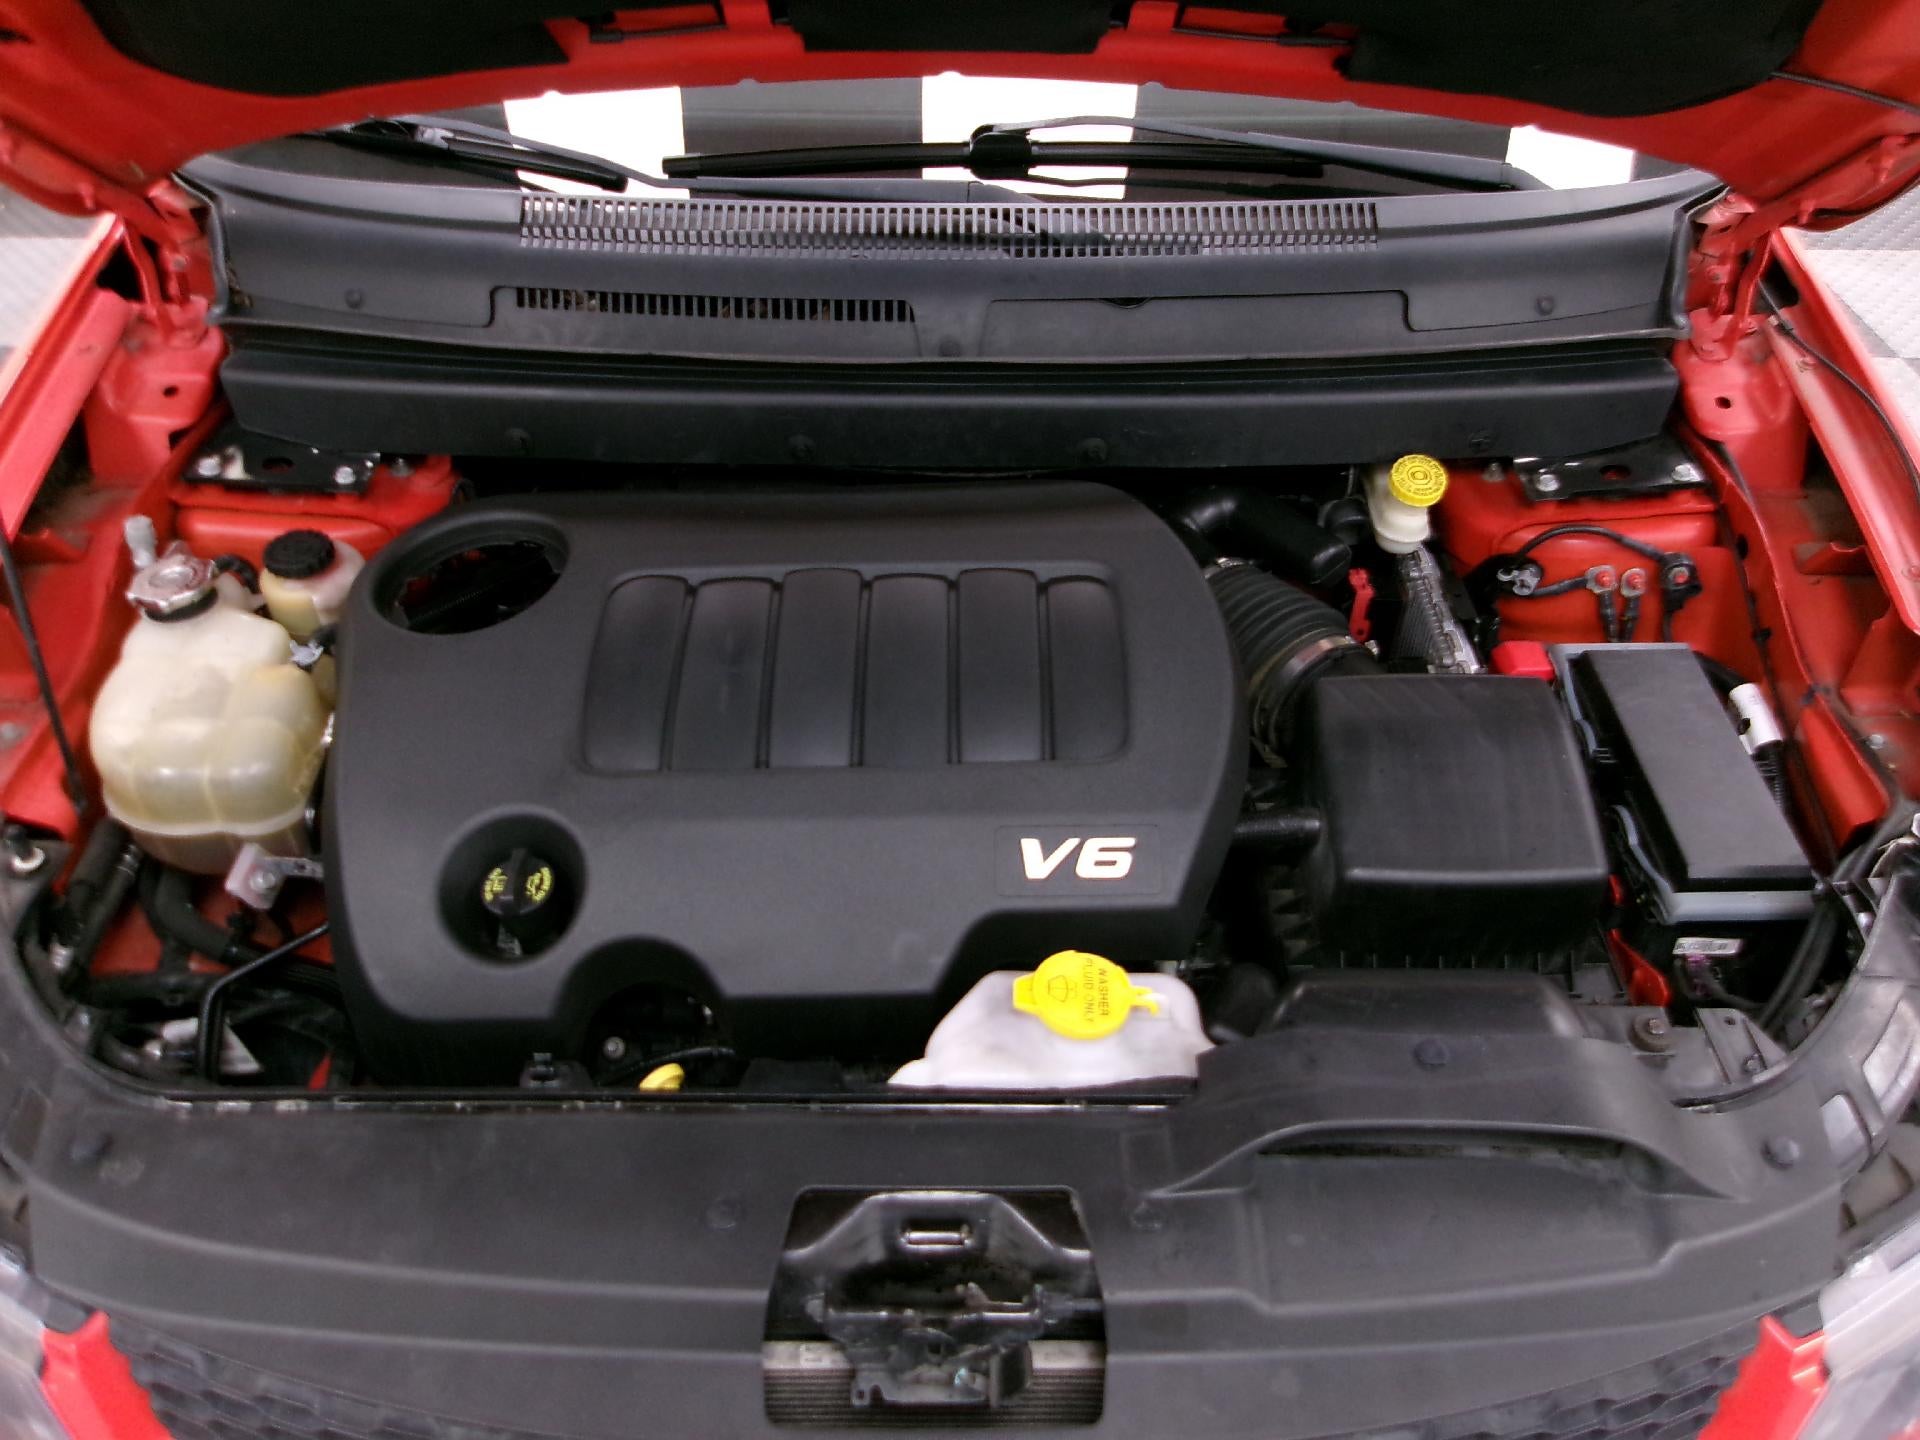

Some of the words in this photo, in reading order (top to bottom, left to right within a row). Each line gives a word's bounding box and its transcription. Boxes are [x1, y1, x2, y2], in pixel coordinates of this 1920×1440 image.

[1020, 837, 1136, 879] V6
[1083, 957, 1095, 990] FLUID
[1098, 968, 1110, 1016] WASHER
[1084, 993, 1095, 1022] ONLY
